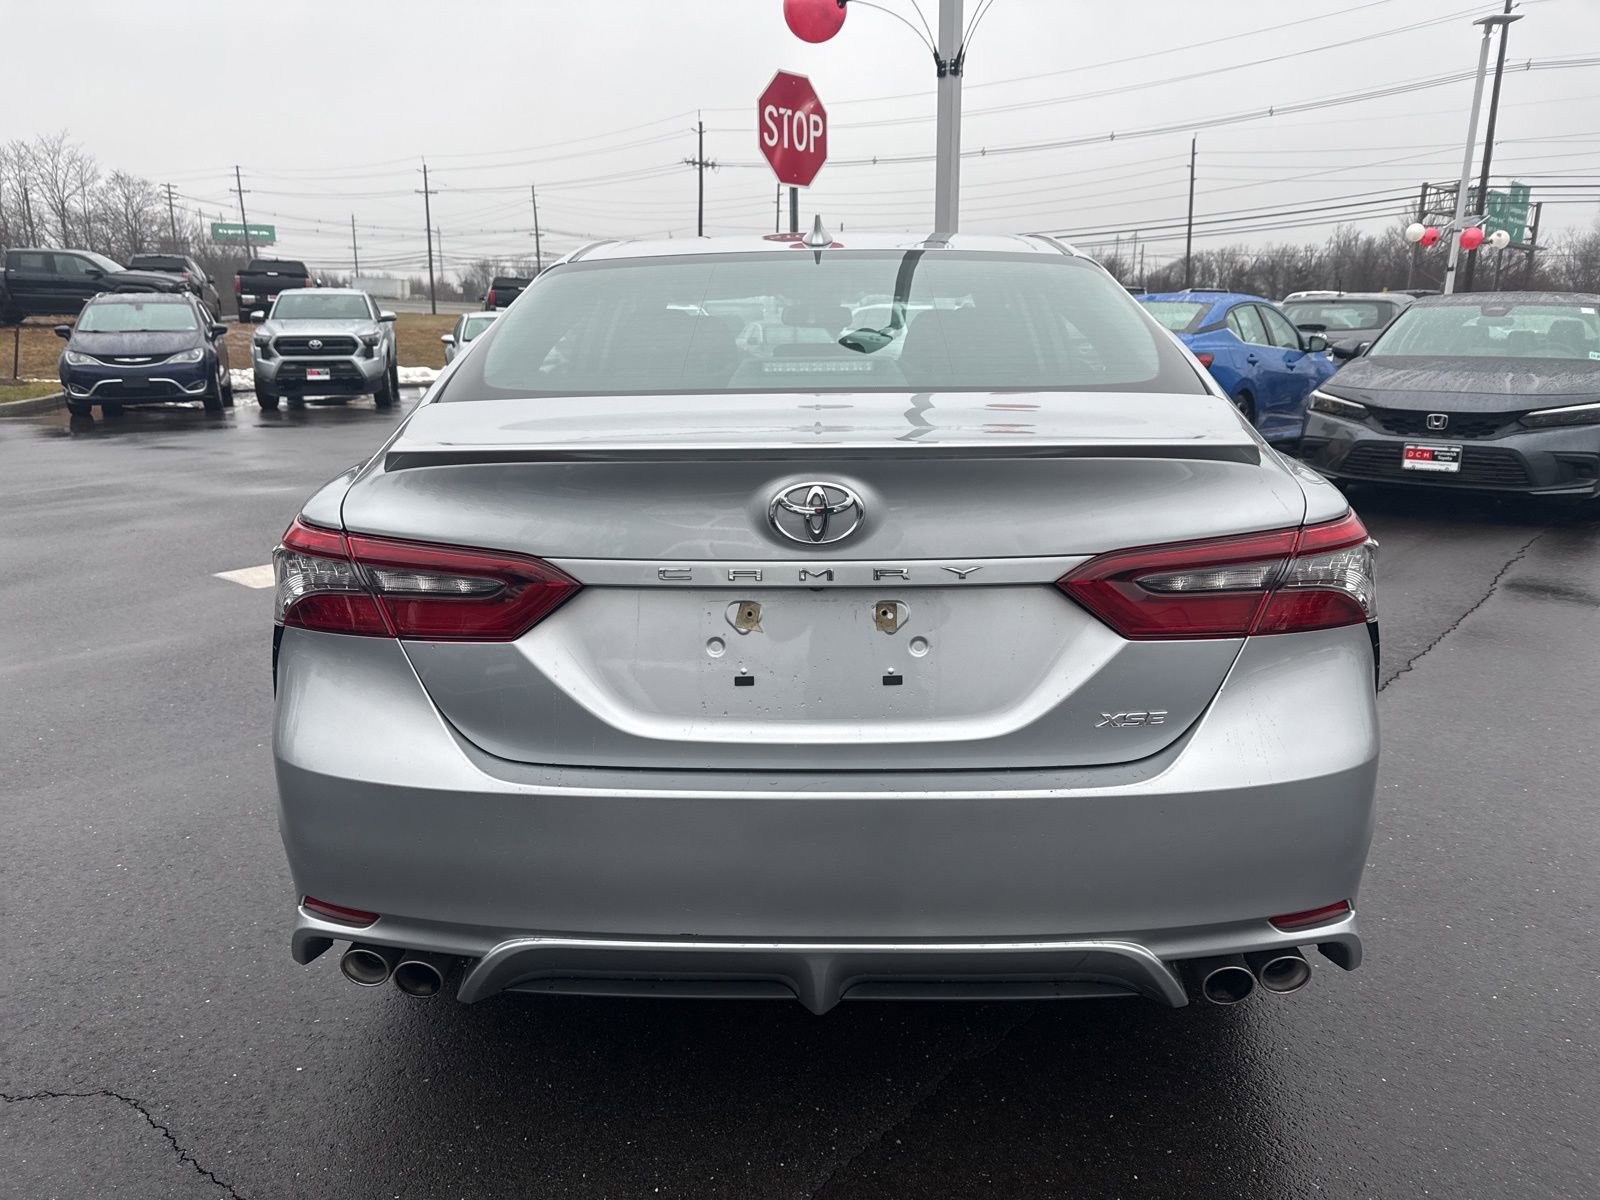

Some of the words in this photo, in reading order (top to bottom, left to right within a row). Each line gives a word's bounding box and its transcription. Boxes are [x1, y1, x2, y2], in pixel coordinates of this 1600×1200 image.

[763, 104, 823, 153] STOP
[657, 566, 984, 582] CAMRY
[1095, 711, 1168, 728] XSE
